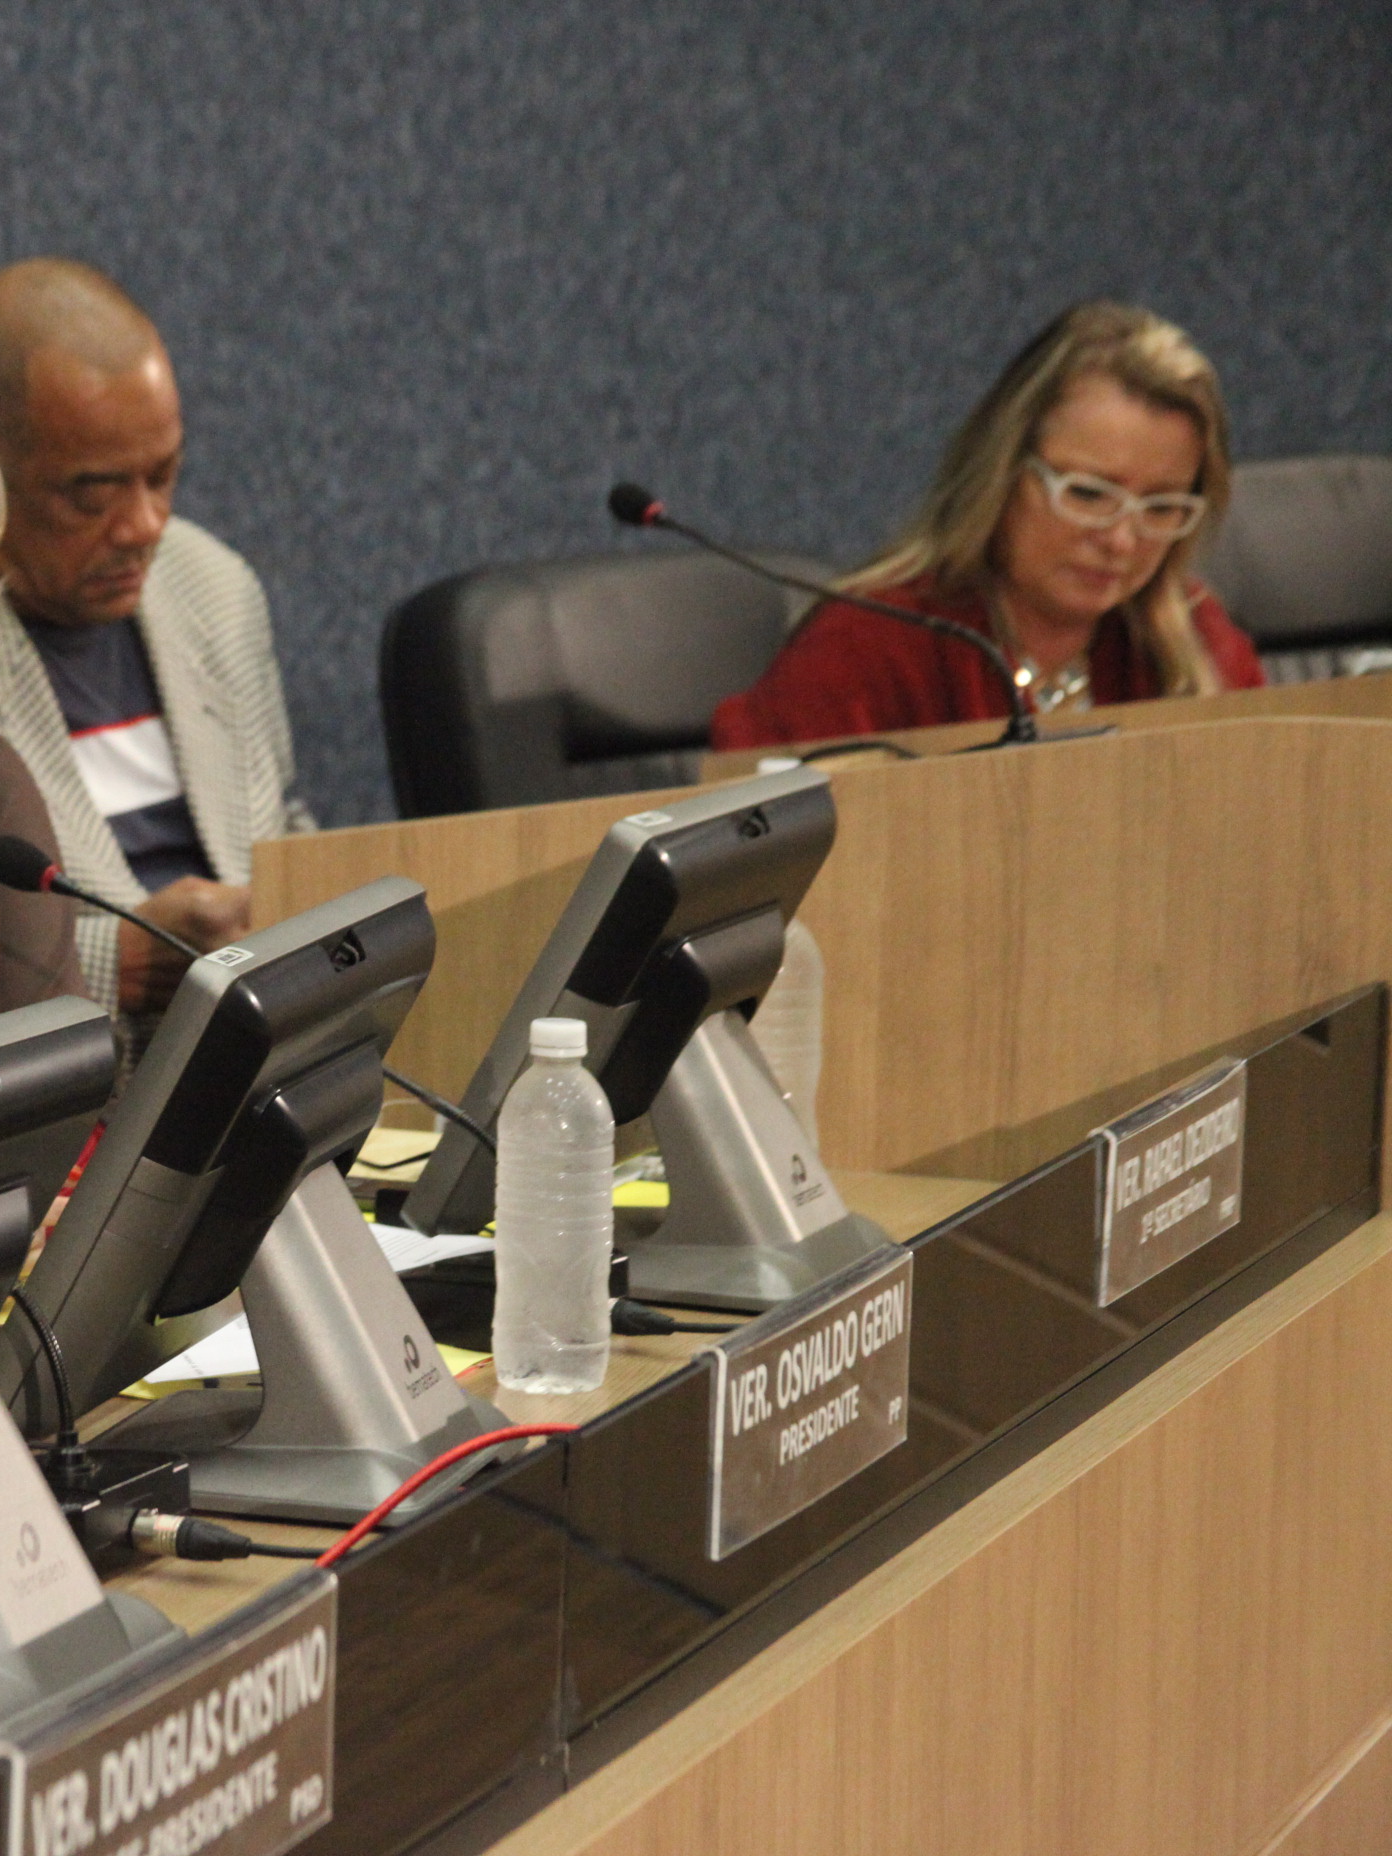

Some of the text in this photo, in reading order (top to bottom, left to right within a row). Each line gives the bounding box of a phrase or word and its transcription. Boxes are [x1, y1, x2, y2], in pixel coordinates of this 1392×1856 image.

[730, 1280, 905, 1437] VER. OSVALDO GERN
[888, 1396, 902, 1425] PP
[779, 1385, 860, 1466] PRESIDENTE
[32, 1625, 327, 1856] VER. DOUGLAS CRISTINO
[149, 1751, 279, 1856] PRESIDENTE
